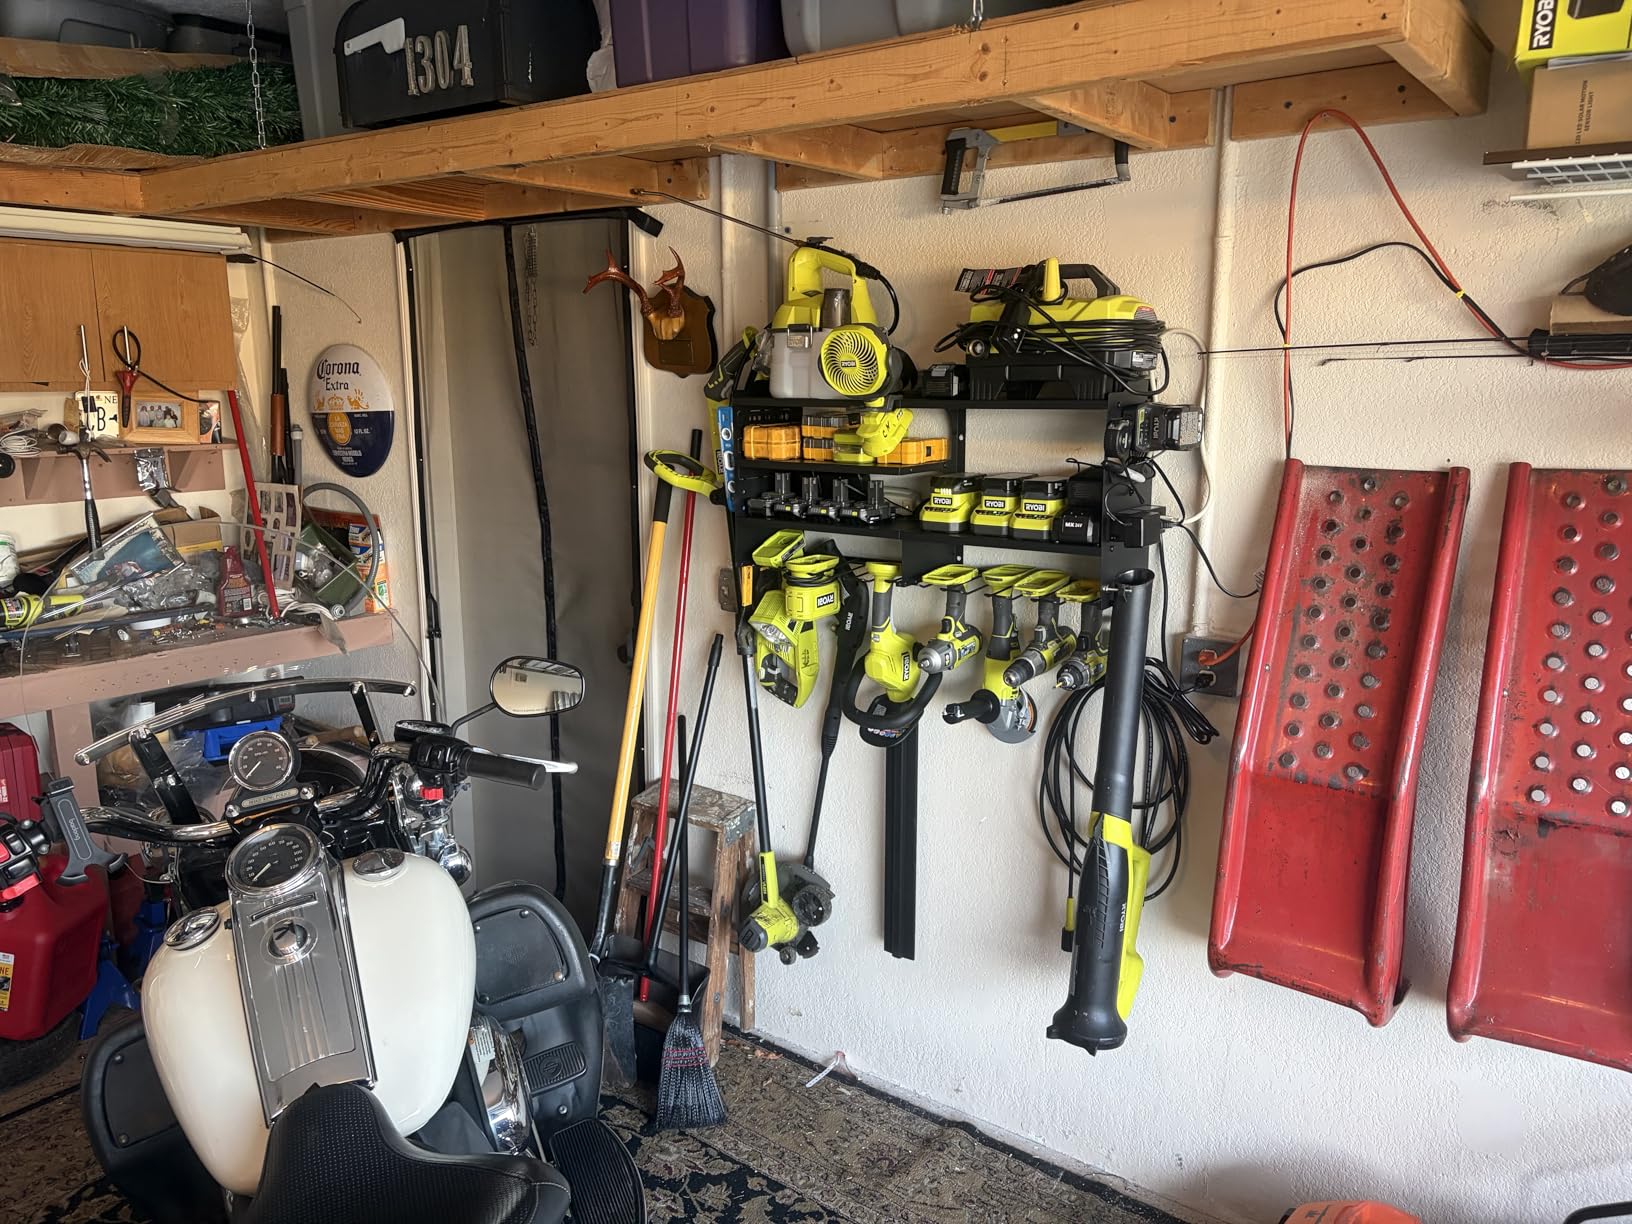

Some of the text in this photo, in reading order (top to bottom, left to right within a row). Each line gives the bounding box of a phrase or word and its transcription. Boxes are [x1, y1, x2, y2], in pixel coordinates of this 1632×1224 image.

[404, 25, 474, 96] 1304
[316, 359, 360, 379] Corona
[325, 378, 349, 391] Extra
[933, 497, 952, 505] RYOBI
[985, 500, 1004, 508] RYOBI
[1025, 503, 1045, 511] RYOBI
[817, 594, 834, 607] RYOBI
[845, 612, 853, 631] RYOBI
